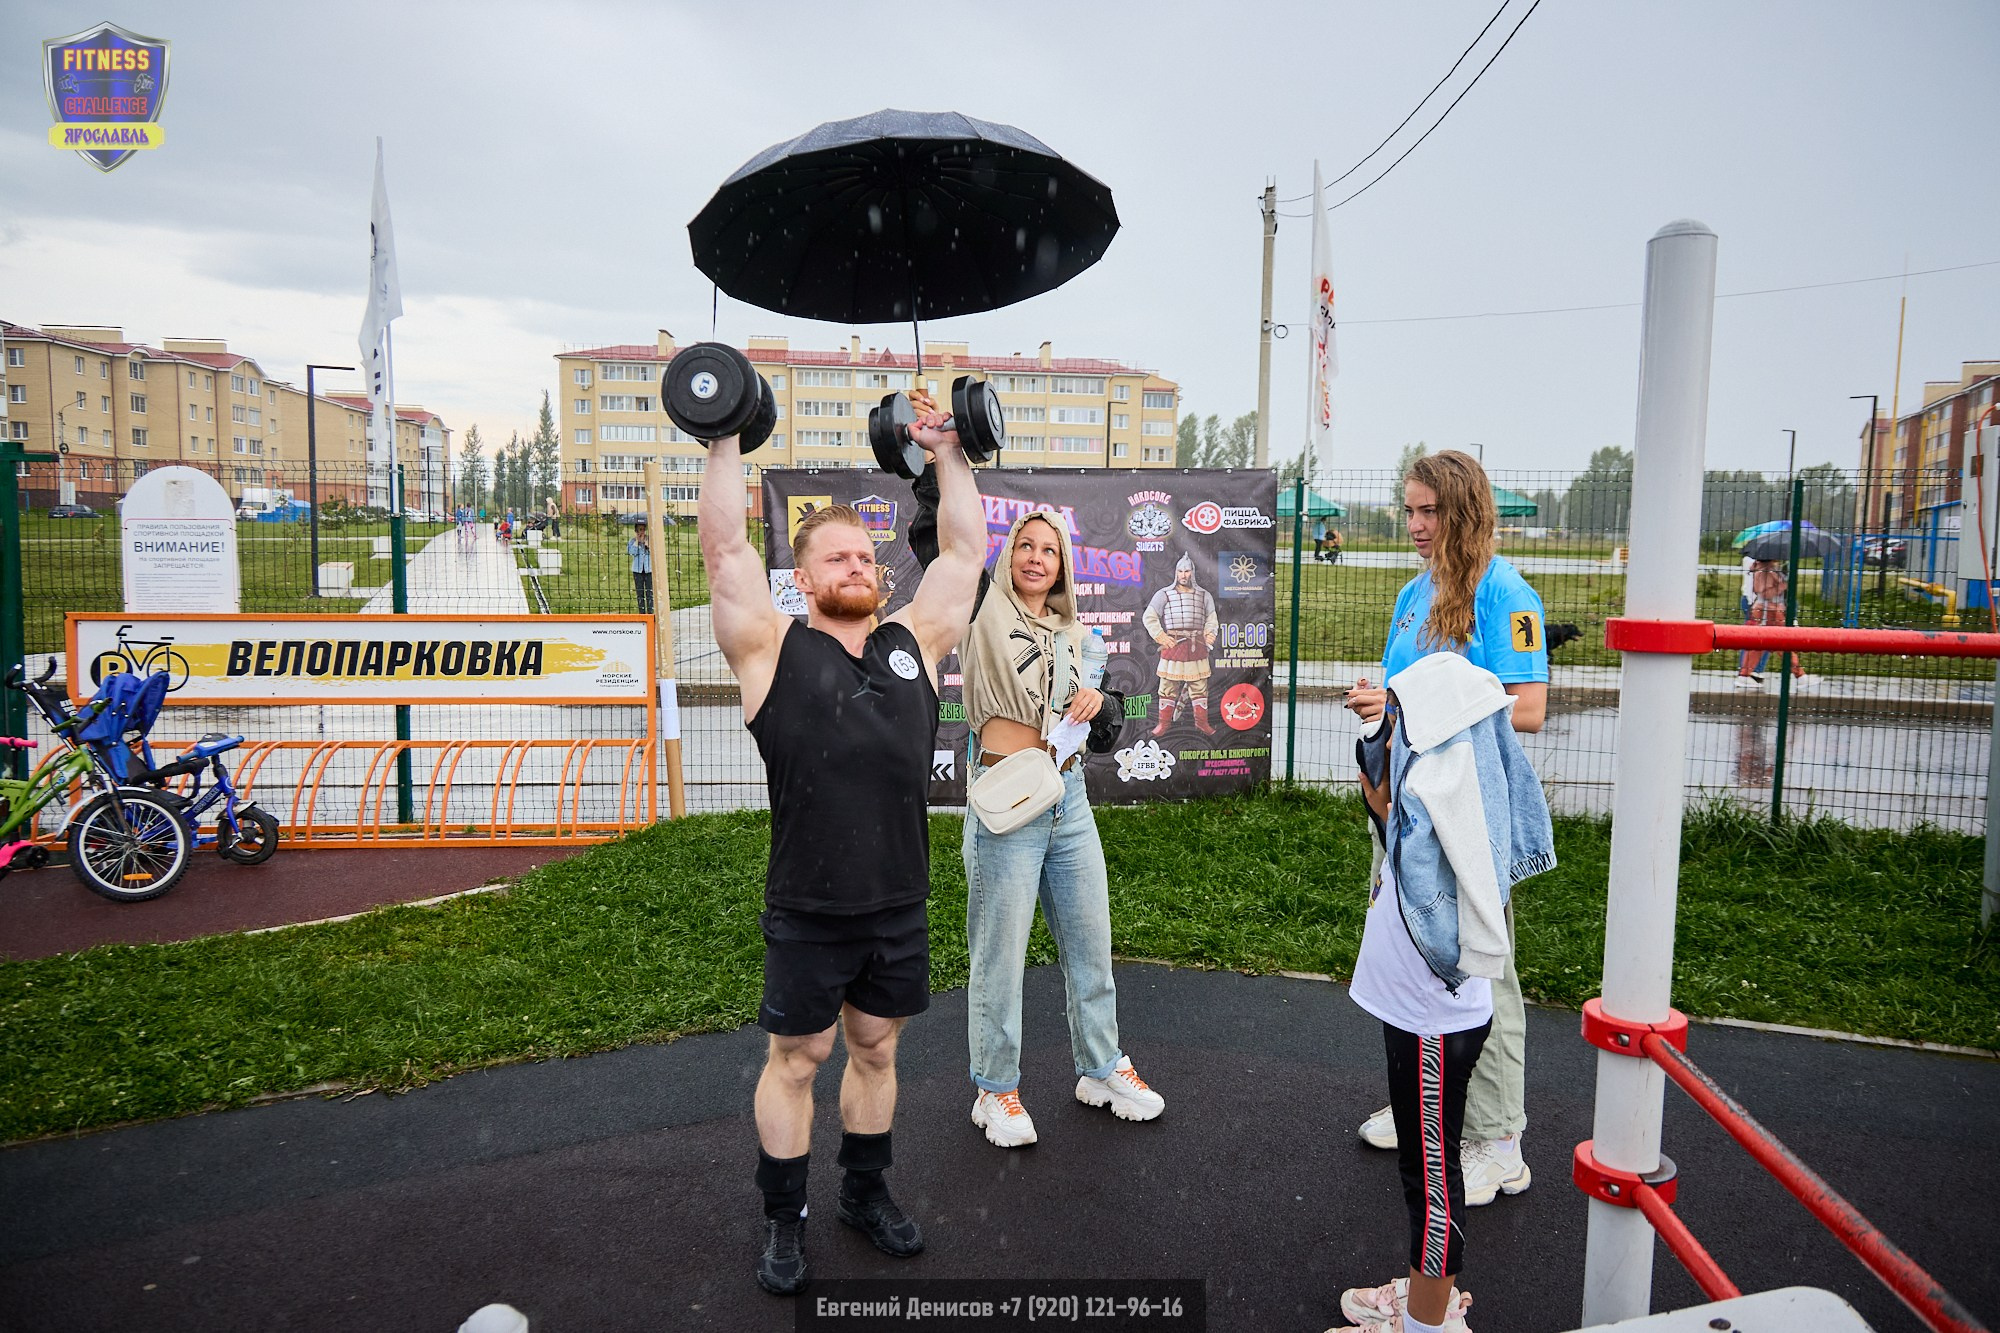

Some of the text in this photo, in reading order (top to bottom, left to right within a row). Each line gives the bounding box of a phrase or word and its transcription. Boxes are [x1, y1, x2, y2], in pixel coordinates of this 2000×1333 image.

[1127, 490, 1171, 507] HARDCORE
[858, 503, 890, 513] FITNESS
[1224, 509, 1258, 518] ПИЦЦА
[1223, 518, 1269, 526] ФАБРИКА
[133, 541, 225, 553] ВНИМАНИЕ!
[1135, 541, 1164, 552] SWEETS
[1094, 583, 1106, 595] НА
[1220, 623, 1267, 648] 10:00
[1119, 641, 1131, 654] НА
[226, 640, 544, 677] ВЕЛОПАРКОВКА
[893, 655, 916, 674] 153
[940, 703, 967, 720] ВЫЗО
